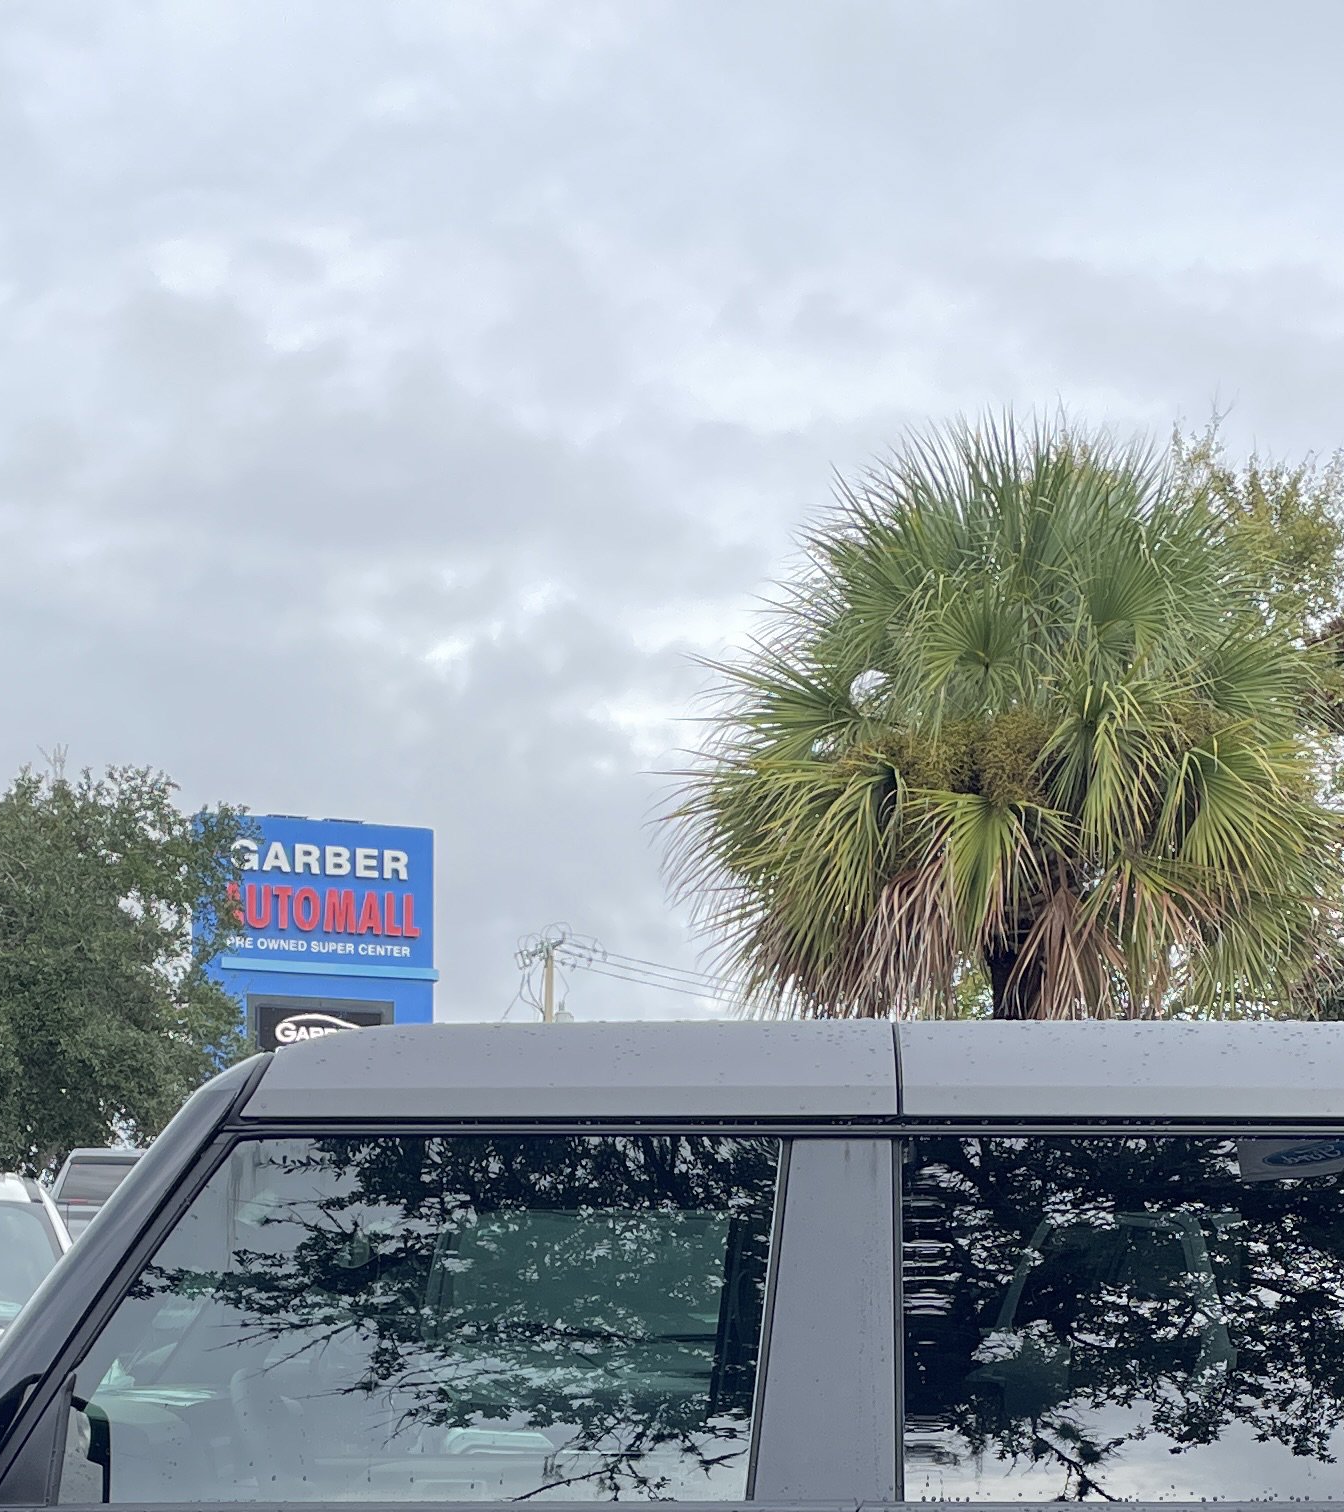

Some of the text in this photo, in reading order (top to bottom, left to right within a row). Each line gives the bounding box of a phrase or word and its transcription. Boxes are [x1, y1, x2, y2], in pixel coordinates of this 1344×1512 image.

[231, 839, 408, 879] GARBER
[226, 935, 411, 958] PRE OWNED SUPER CENTER
